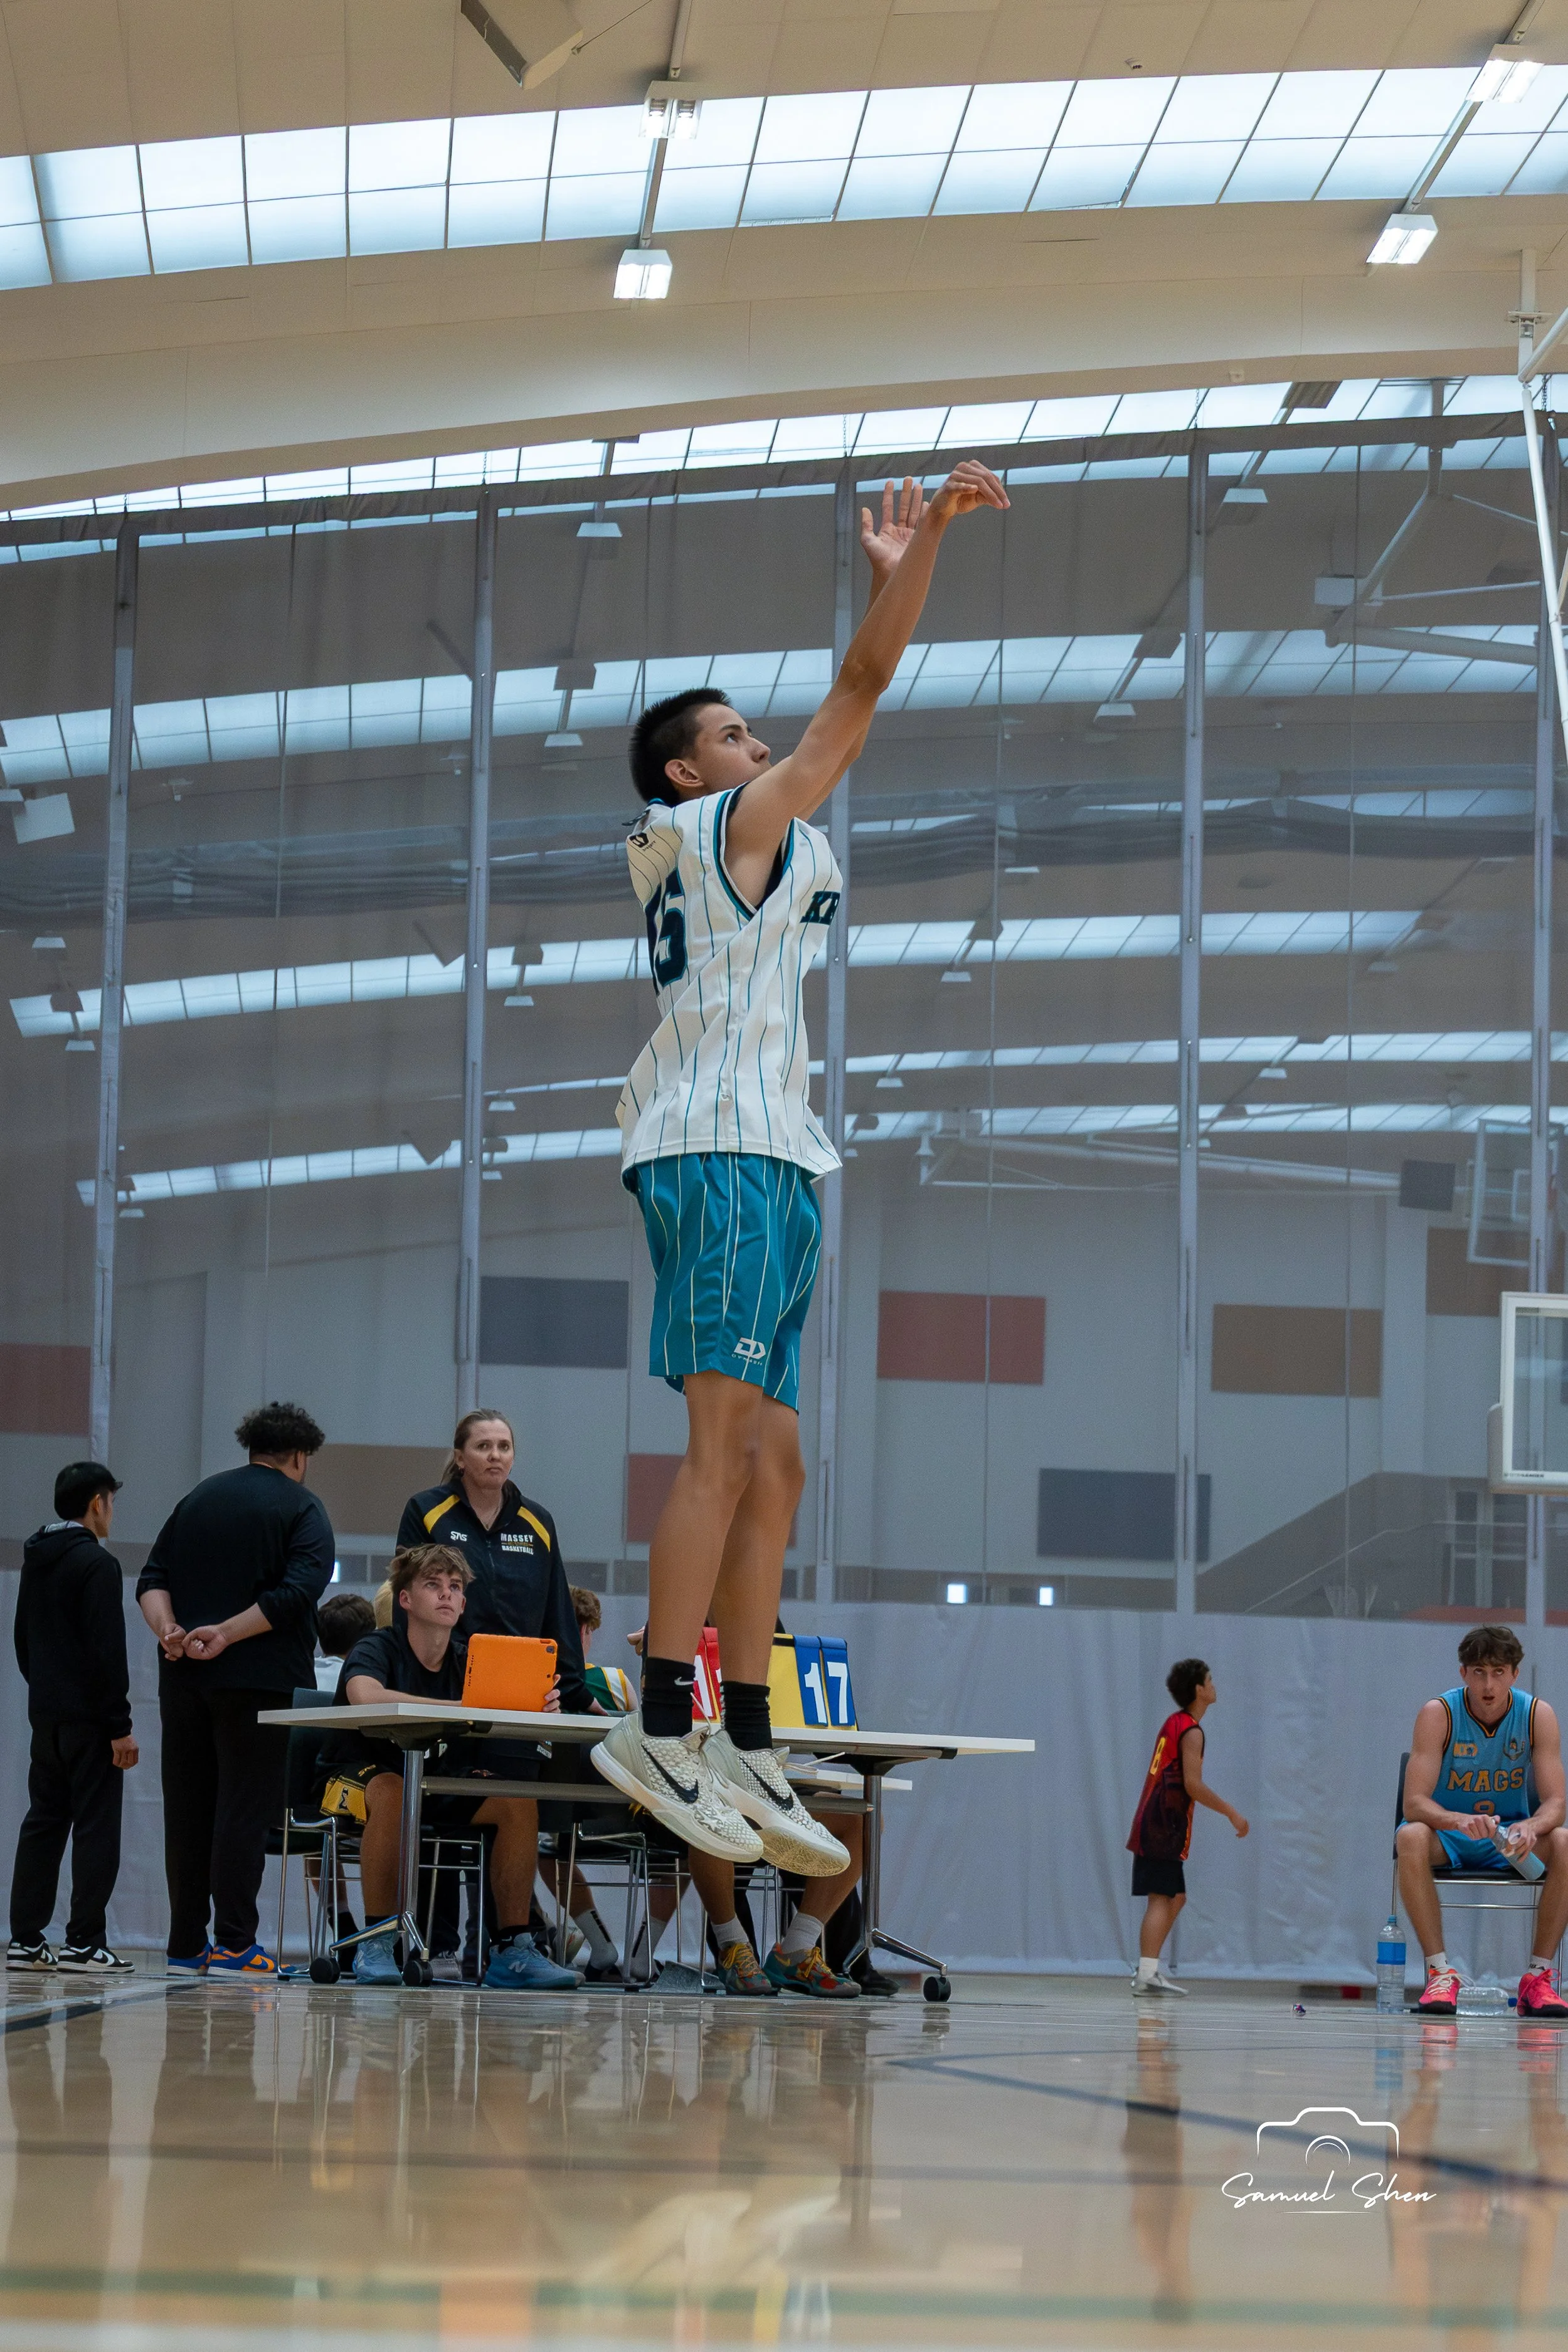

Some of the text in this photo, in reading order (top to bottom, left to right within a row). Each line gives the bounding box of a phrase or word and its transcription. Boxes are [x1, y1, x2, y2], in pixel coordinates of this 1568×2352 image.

[501, 1533, 533, 1542] MASSEY
[501, 1545, 534, 1555] BASKETBALL
[804, 1661, 848, 1724] 17
[1446, 1767, 1524, 1792] MAGS
